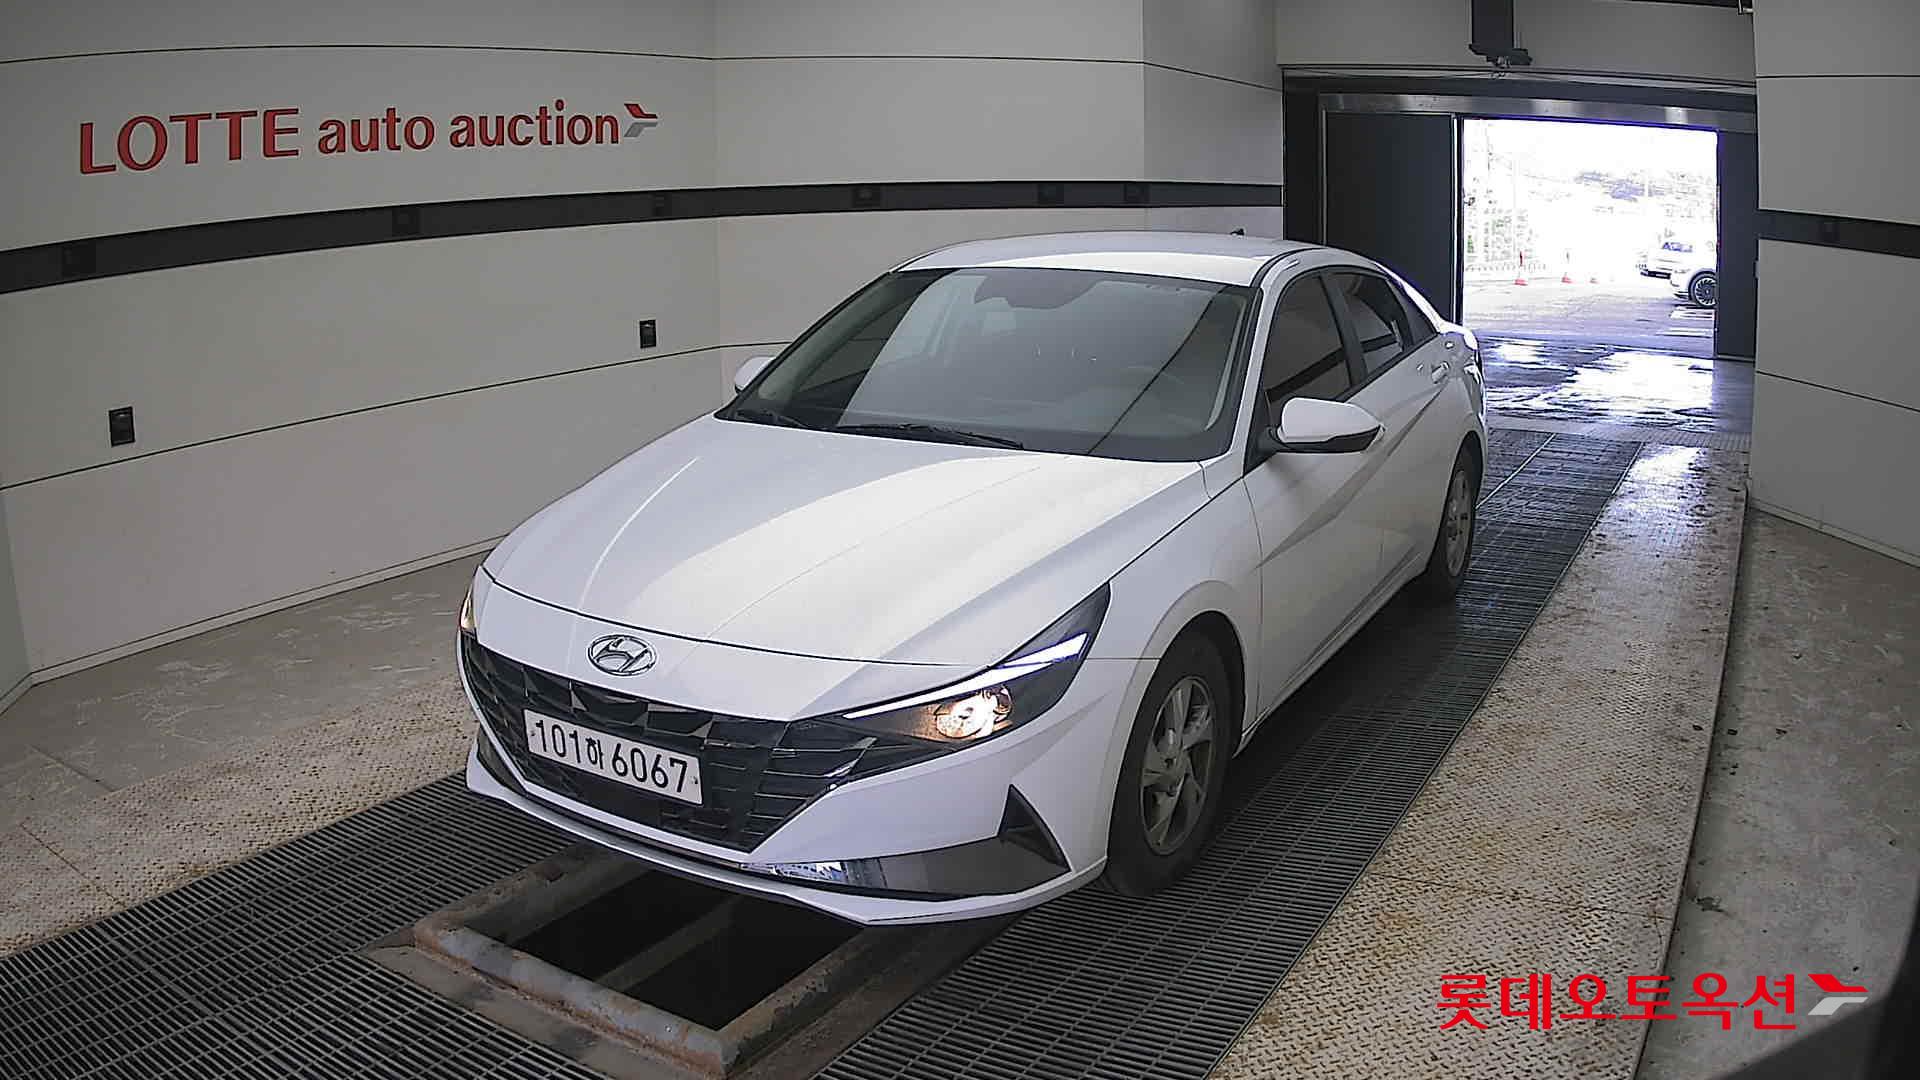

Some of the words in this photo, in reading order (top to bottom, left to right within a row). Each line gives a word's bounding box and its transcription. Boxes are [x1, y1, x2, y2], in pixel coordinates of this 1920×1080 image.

[80, 109, 299, 174] LOTTE
[318, 107, 435, 154] auto
[450, 100, 620, 149] auction
